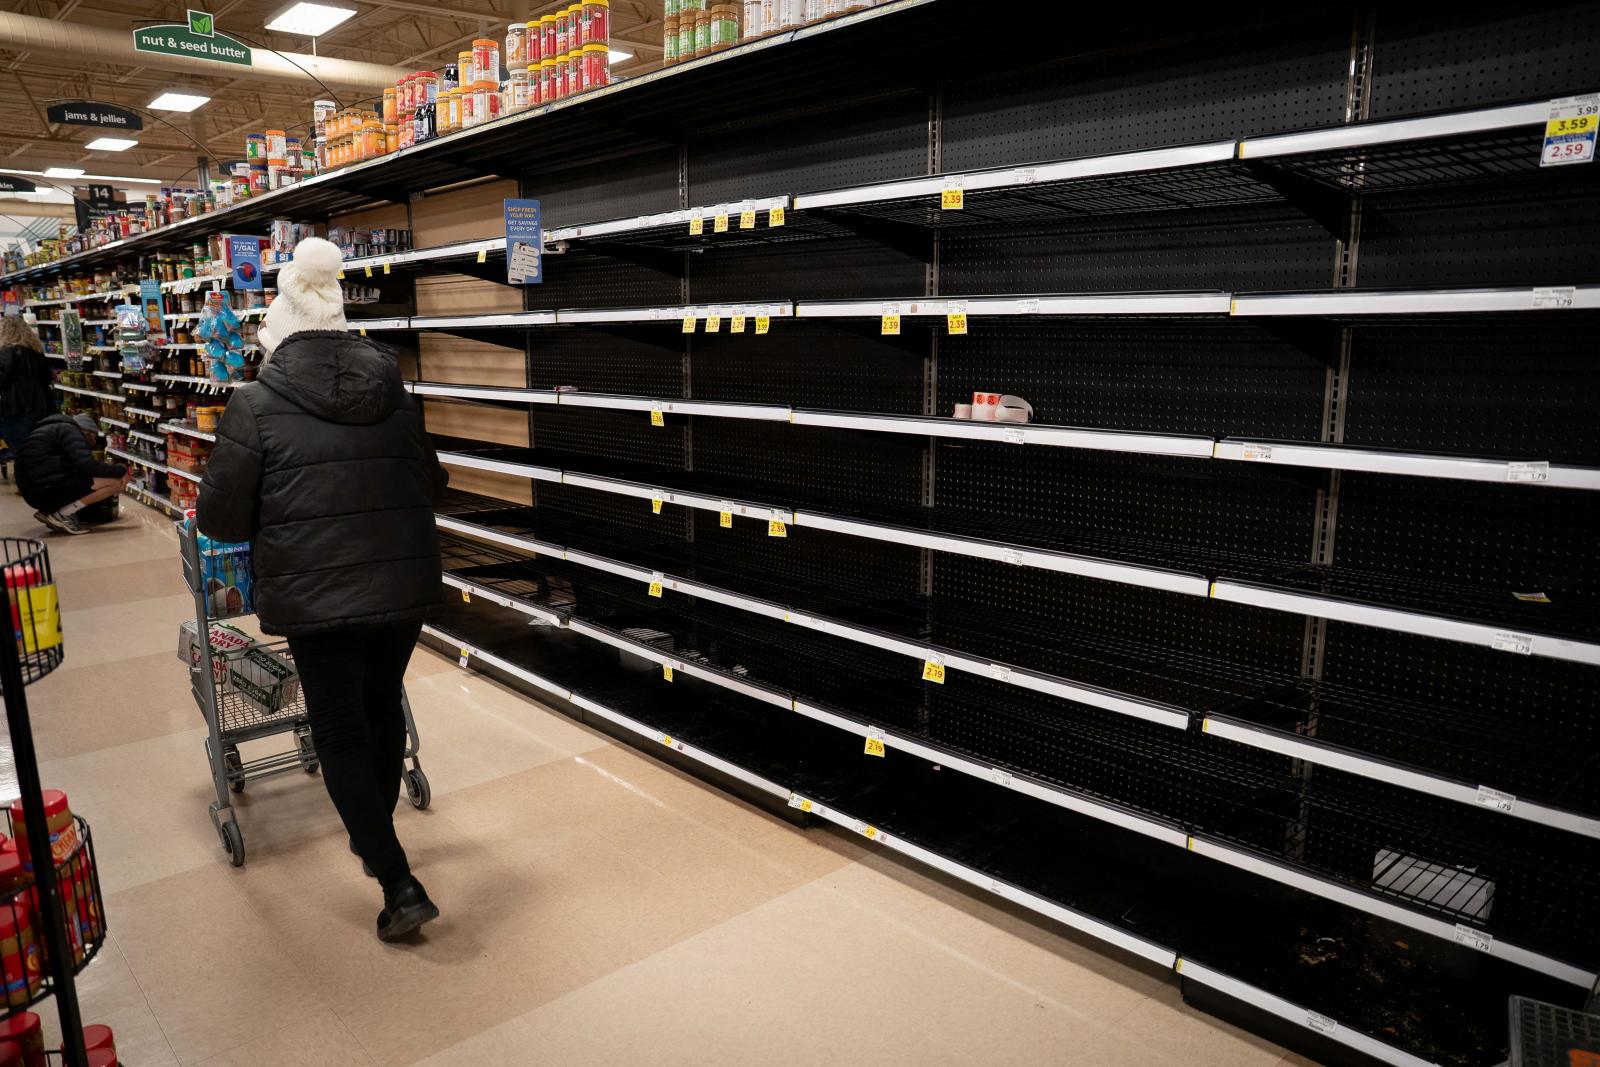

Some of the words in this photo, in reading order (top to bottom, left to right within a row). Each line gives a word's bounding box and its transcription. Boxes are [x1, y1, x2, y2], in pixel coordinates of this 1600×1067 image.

[142, 34, 164, 48] nut
[168, 37, 177, 49] &
[180, 39, 208, 53] seed
[211, 41, 246, 60] butter
[1577, 105, 1598, 116] 3.99
[64, 110, 88, 121] jams
[90, 112, 99, 122] &
[100, 113, 127, 125] jellies
[1558, 118, 1588, 131] 3.59
[1551, 143, 1584, 158] 2.59
[94, 187, 109, 199] 14
[943, 195, 961, 204] 2.39
[883, 321, 899, 330] 2.39
[949, 320, 966, 330] 2.39
[209, 636, 235, 649] DRY
[926, 667, 943, 678] 2.19
[867, 742, 883, 753] 2.19
